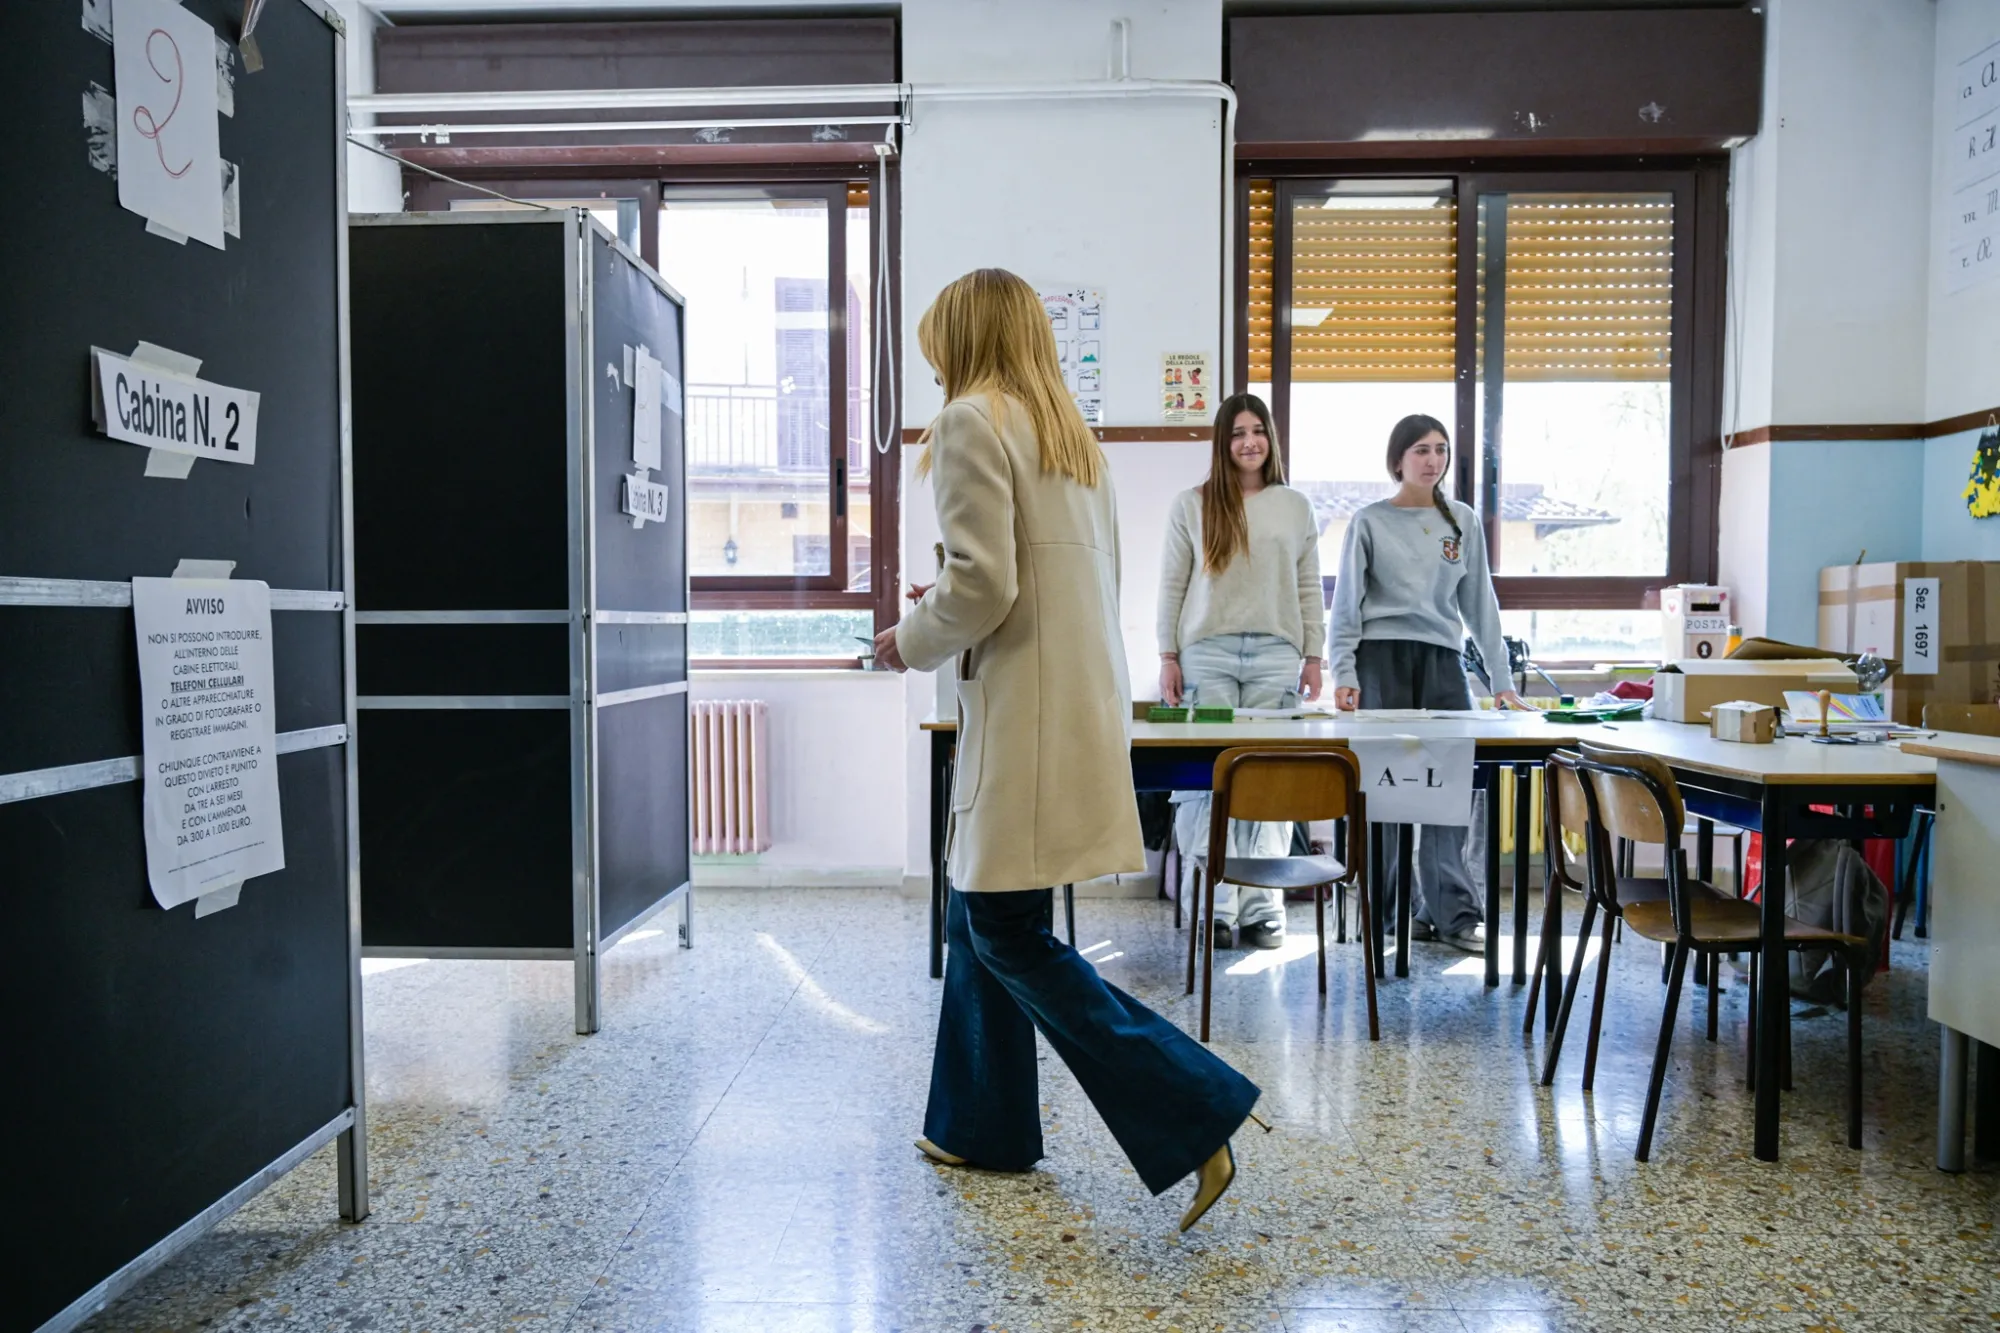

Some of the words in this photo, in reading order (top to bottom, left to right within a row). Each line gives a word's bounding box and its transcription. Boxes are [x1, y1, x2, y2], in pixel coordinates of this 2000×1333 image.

[116, 372, 188, 443] Cabina
[193, 393, 216, 448] N.
[225, 401, 240, 451] 2
[657, 491, 663, 516] 3
[186, 598, 225, 615] AVVISO
[1915, 587, 1930, 613] Sez.
[1685, 619, 1727, 630] POSTA
[148, 632, 169, 645] NON
[170, 632, 177, 644] SI
[178, 631, 215, 643] POSSONO
[1915, 623, 1929, 658] 1697
[174, 646, 219, 659] ALL'INTERNO
[220, 645, 239, 656] DELLE
[173, 663, 200, 675] CABINE
[170, 679, 206, 693] TELEFONI
[208, 675, 244, 689] CELLULARI
[161, 698, 169, 710] O
[170, 695, 192, 709] ALTRE
[193, 688, 255, 706] APPARECCHIATURE
[155, 716, 164, 727] IN
[165, 711, 194, 725] GRADO
[195, 710, 203, 721] DI
[205, 703, 253, 720] FOTOGRAFARE
[254, 702, 262, 713] O
[170, 724, 212, 741] REGISTRARE
[213, 719, 248, 734] IMMAGINI.
[158, 756, 201, 774] CHIUNQUE
[202, 745, 255, 765] CONTRAVVIENE
[256, 745, 262, 755] A
[164, 771, 197, 788] QUESTO
[198, 765, 224, 780] DIVIETO
[231, 759, 258, 773] PUNITO
[1377, 766, 1398, 787] A
[1425, 767, 1443, 788] L
[187, 786, 205, 798] CON
[206, 776, 239, 794] L'ARRESTO
[184, 803, 196, 814] DA
[197, 798, 208, 811] TRE
[210, 797, 215, 807] A
[216, 794, 226, 806] SEI
[227, 789, 243, 803] MESI
[182, 818, 187, 830] E
[188, 815, 206, 828] CON
[207, 803, 247, 823] L'AMMENDA
[176, 835, 189, 846] DA
[190, 829, 204, 842] 300
[205, 828, 211, 838] A
[212, 821, 230, 836] 1.000
[231, 815, 253, 830] EURO.
